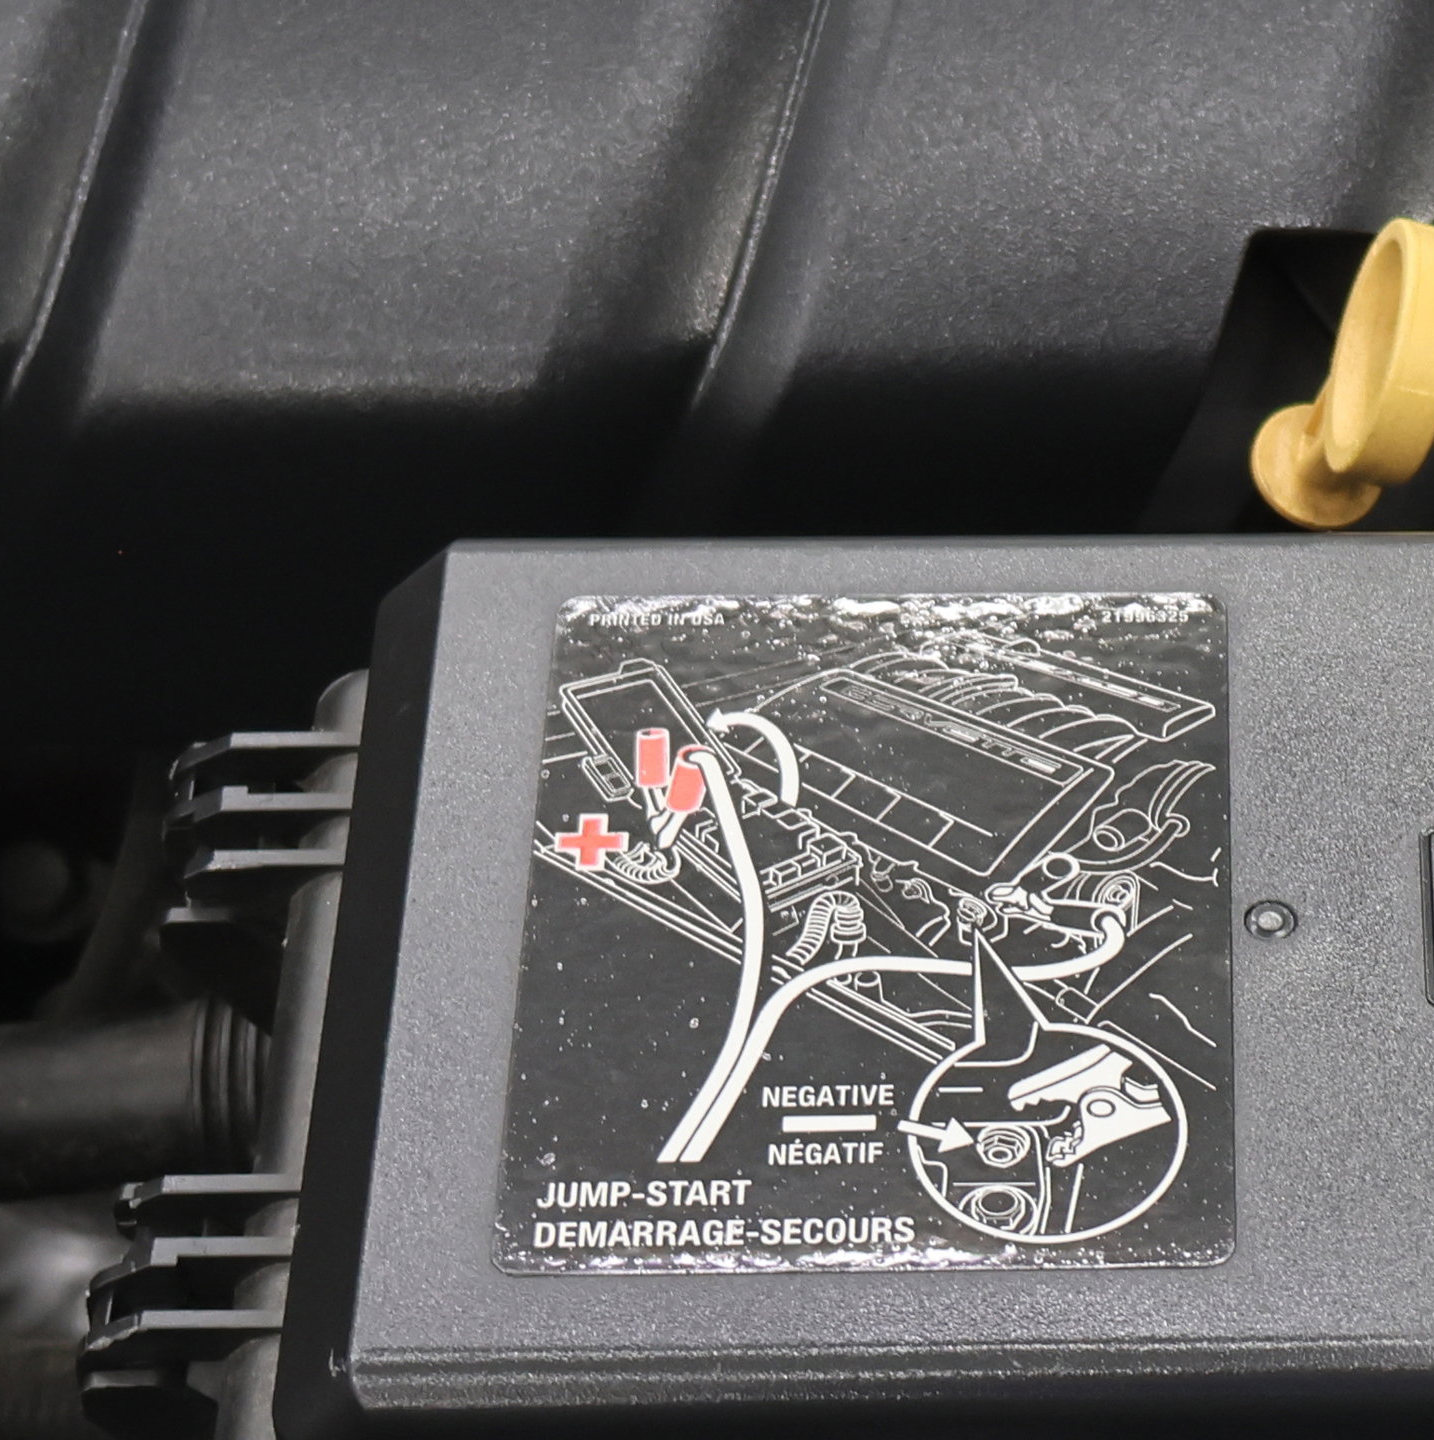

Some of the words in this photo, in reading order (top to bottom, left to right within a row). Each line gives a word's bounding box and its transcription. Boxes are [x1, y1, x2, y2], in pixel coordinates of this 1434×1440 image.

[588, 613, 662, 626] PRINTED
[667, 613, 685, 626] IN
[691, 613, 725, 625] USA
[761, 1084, 895, 1108] NEGATIVE
[767, 1139, 884, 1165] NÉGATIF
[536, 1179, 753, 1208] JUMP-START
[533, 1216, 916, 1248] DEMARRAGE-SECOURS
